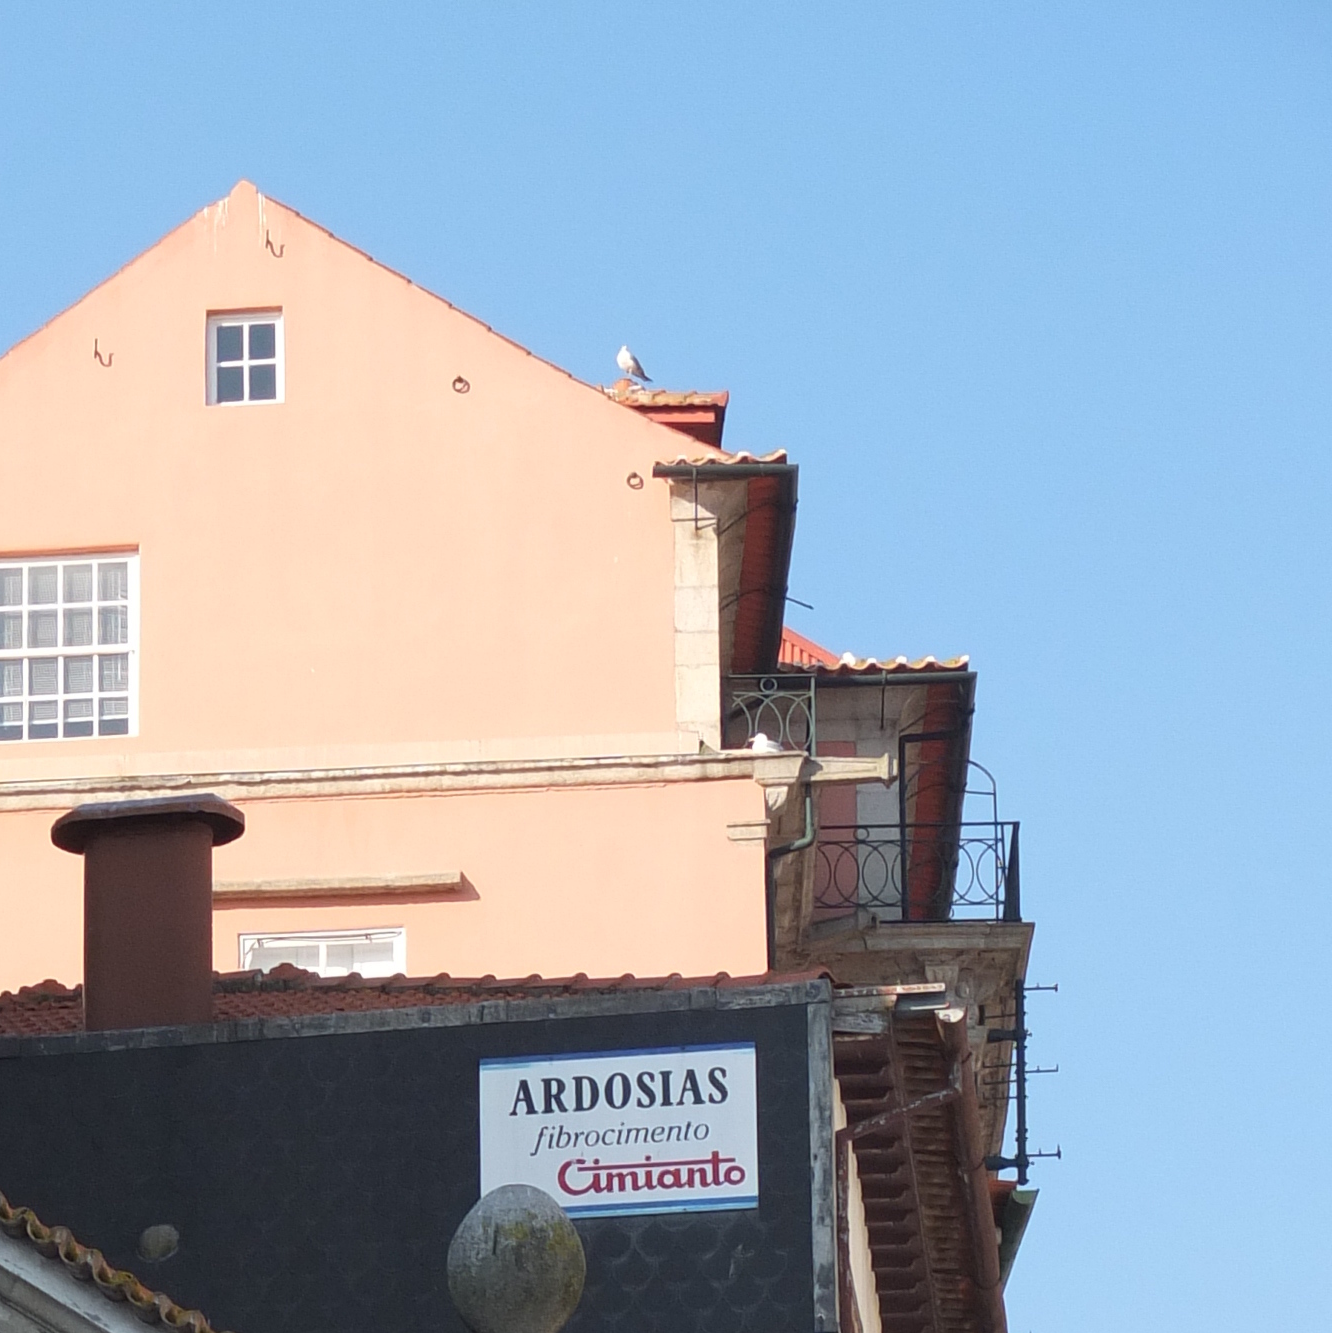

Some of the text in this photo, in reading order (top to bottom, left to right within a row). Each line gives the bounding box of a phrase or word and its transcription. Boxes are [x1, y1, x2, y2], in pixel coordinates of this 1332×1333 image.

[509, 1066, 729, 1116] ARDOSIAS
[530, 1120, 710, 1157] fibrocimento
[557, 1150, 746, 1196] Cimianto
